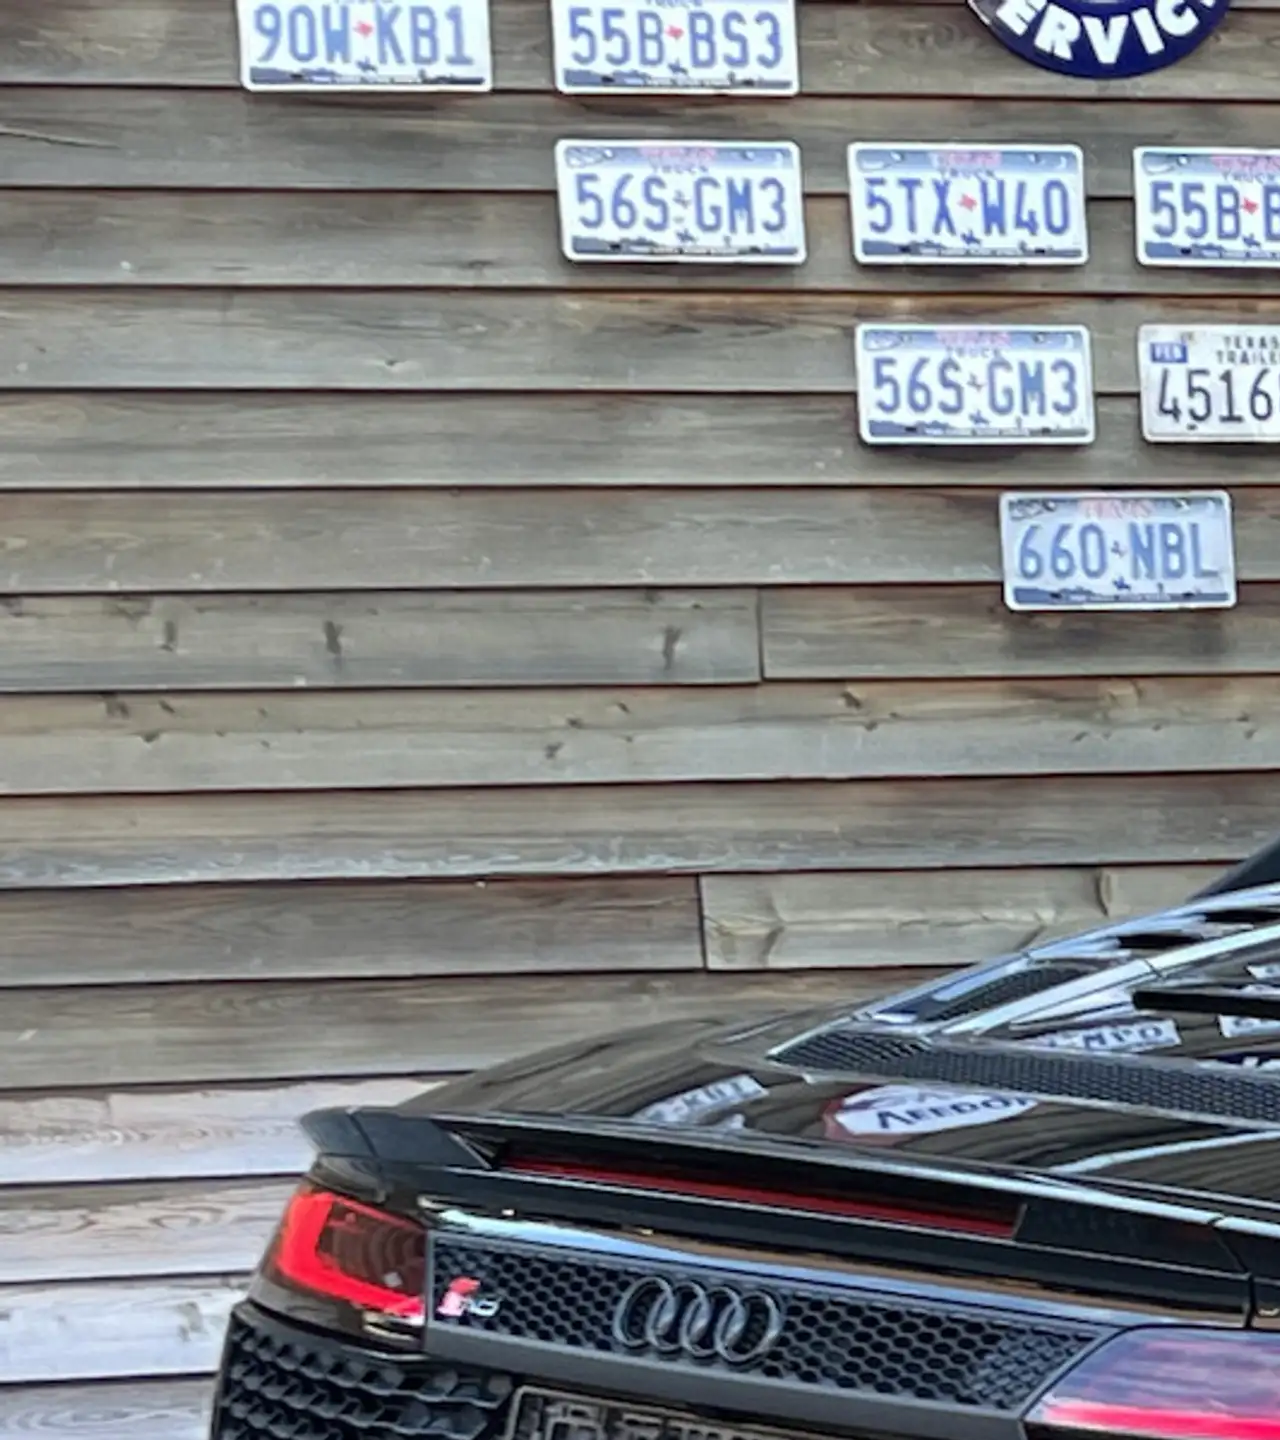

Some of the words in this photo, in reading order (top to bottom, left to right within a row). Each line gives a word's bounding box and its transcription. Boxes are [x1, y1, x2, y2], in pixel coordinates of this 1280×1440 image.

[574, 173, 670, 232] 56S
[694, 176, 788, 235] GM3
[863, 177, 957, 237] 5TX
[980, 179, 1071, 237] W40
[1149, 181, 1242, 241] 55B
[872, 356, 965, 415] 56S
[987, 358, 1078, 417] GM3
[1128, 522, 1221, 581] NBL
